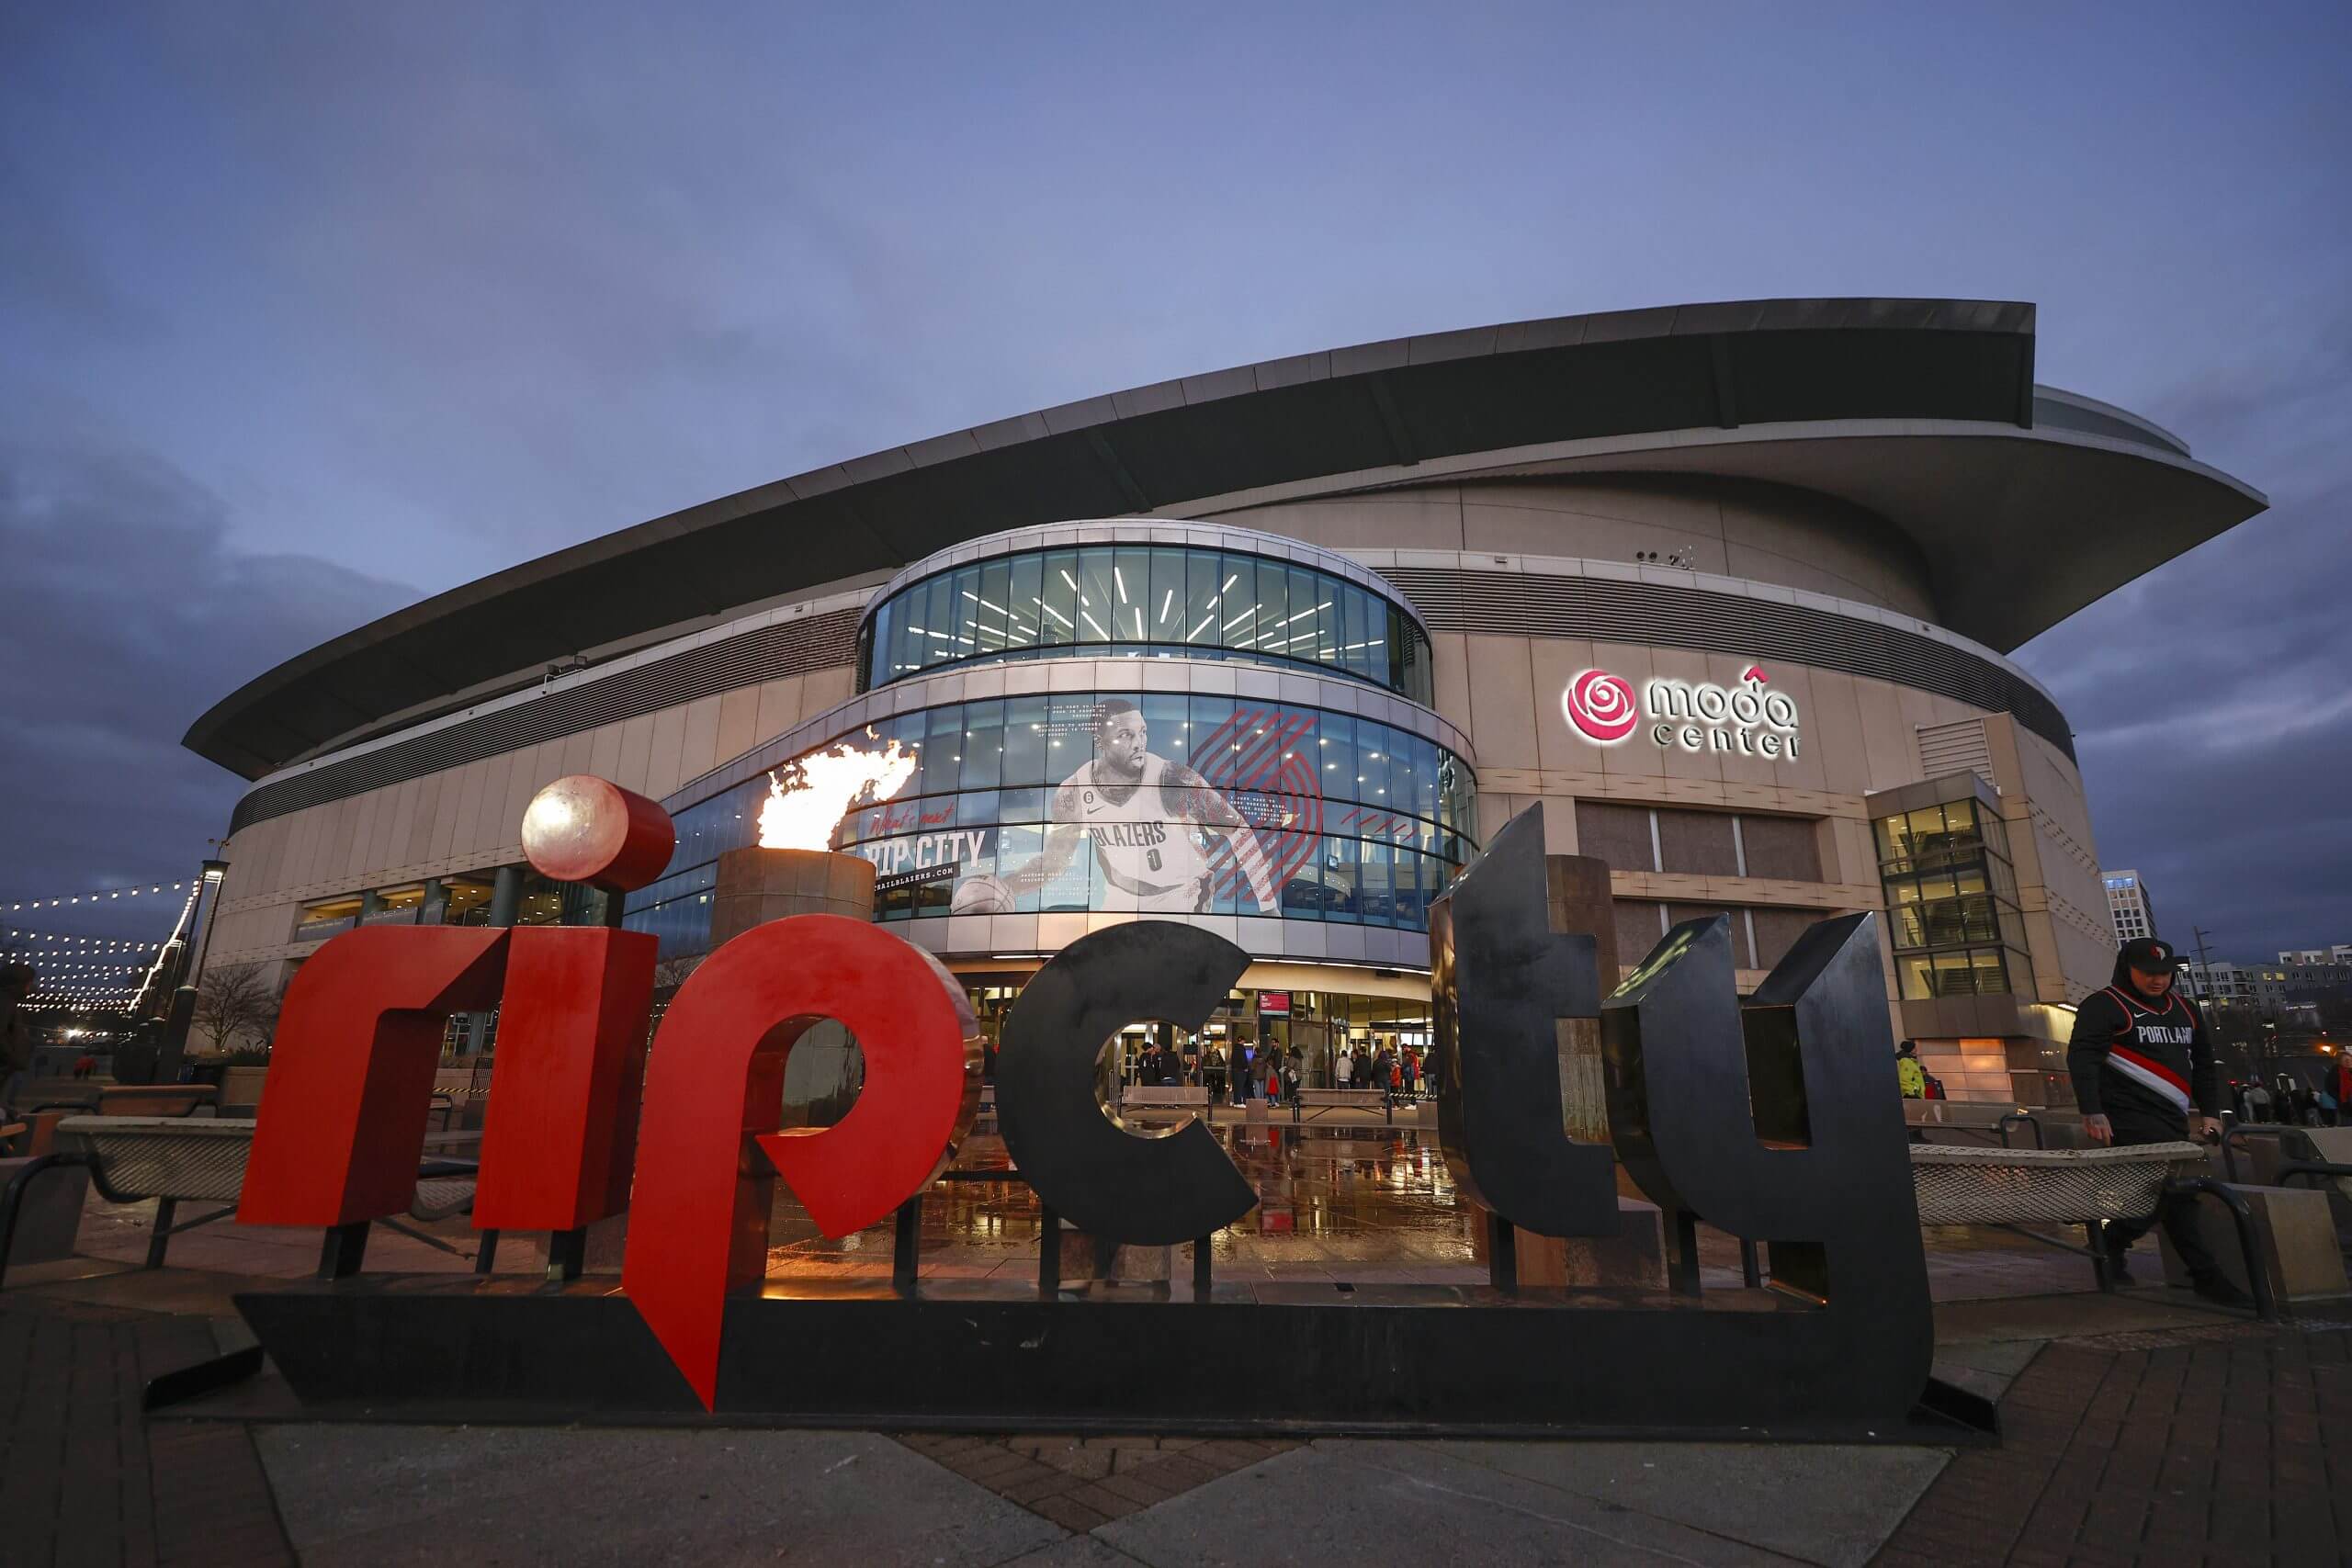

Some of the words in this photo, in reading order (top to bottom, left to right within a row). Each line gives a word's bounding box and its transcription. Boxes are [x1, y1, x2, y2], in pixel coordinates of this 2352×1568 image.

[1648, 666, 1800, 728] moda
[1654, 722, 1802, 758] center
[1089, 820, 1167, 847] BLAZERS
[865, 839, 910, 879] RIP
[916, 830, 986, 871] CITY
[2136, 1025, 2192, 1044] PORTLAN
